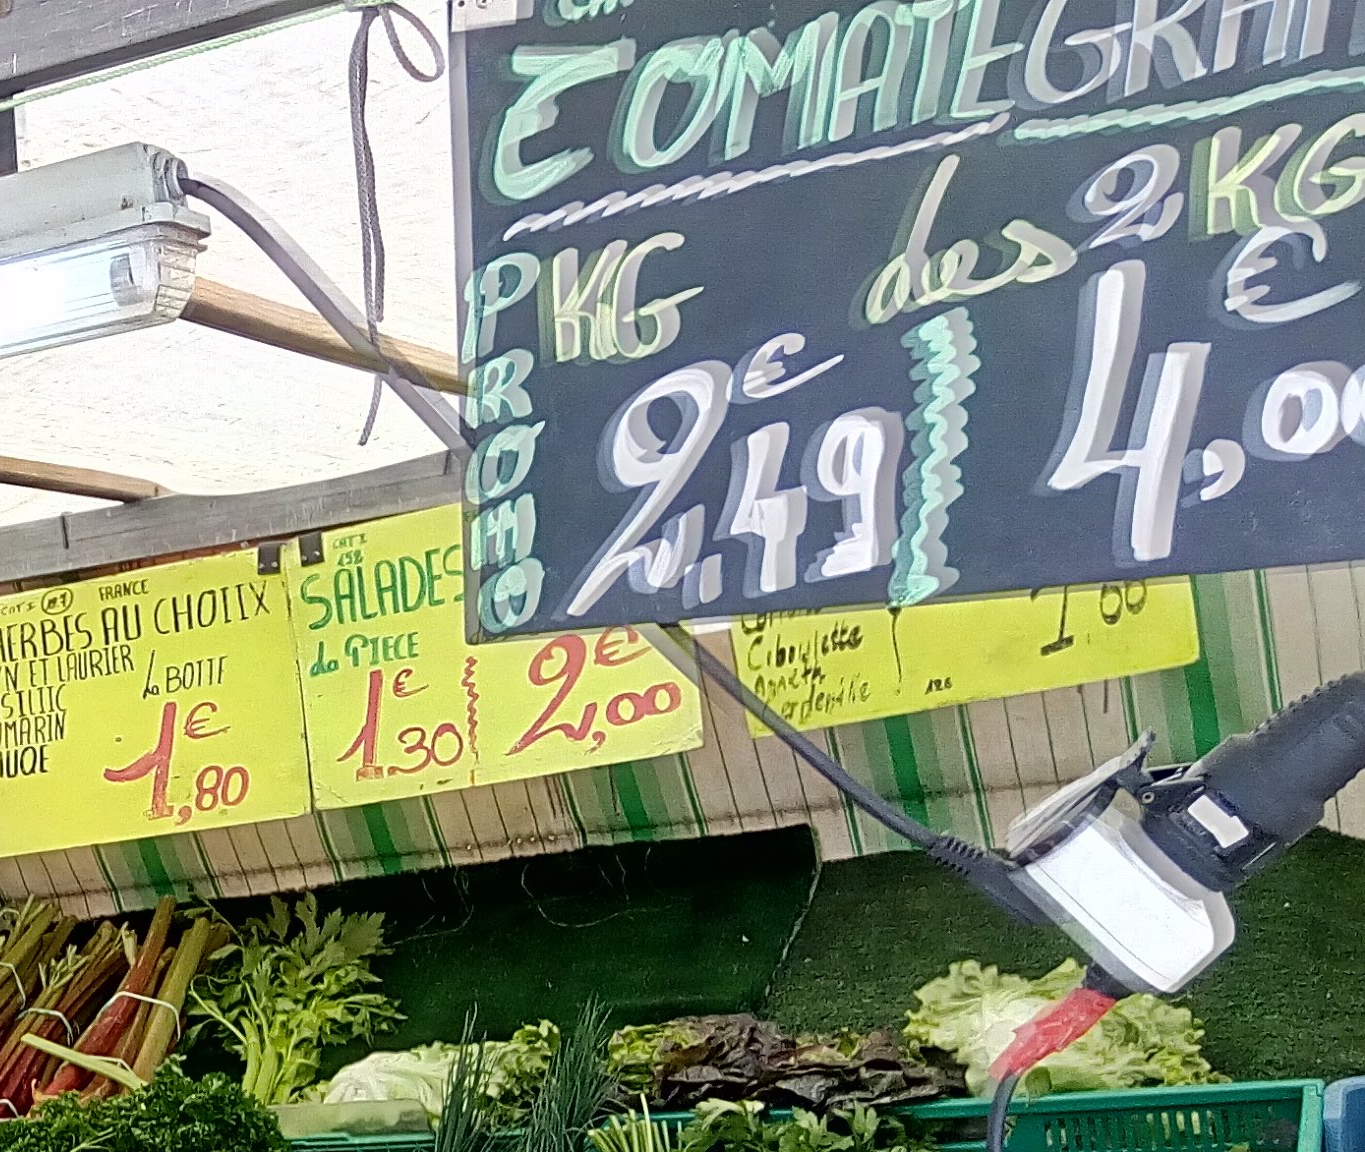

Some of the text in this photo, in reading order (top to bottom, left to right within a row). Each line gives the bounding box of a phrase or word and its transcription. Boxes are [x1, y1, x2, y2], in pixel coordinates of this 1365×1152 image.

[537, 230, 705, 364] KG
[462, 253, 544, 636] PROMO
[98, 579, 149, 602] FRANCE
[100, 603, 143, 646] AU
[29, 644, 136, 689] ET LAURIER
[344, 632, 419, 668] PIECE
